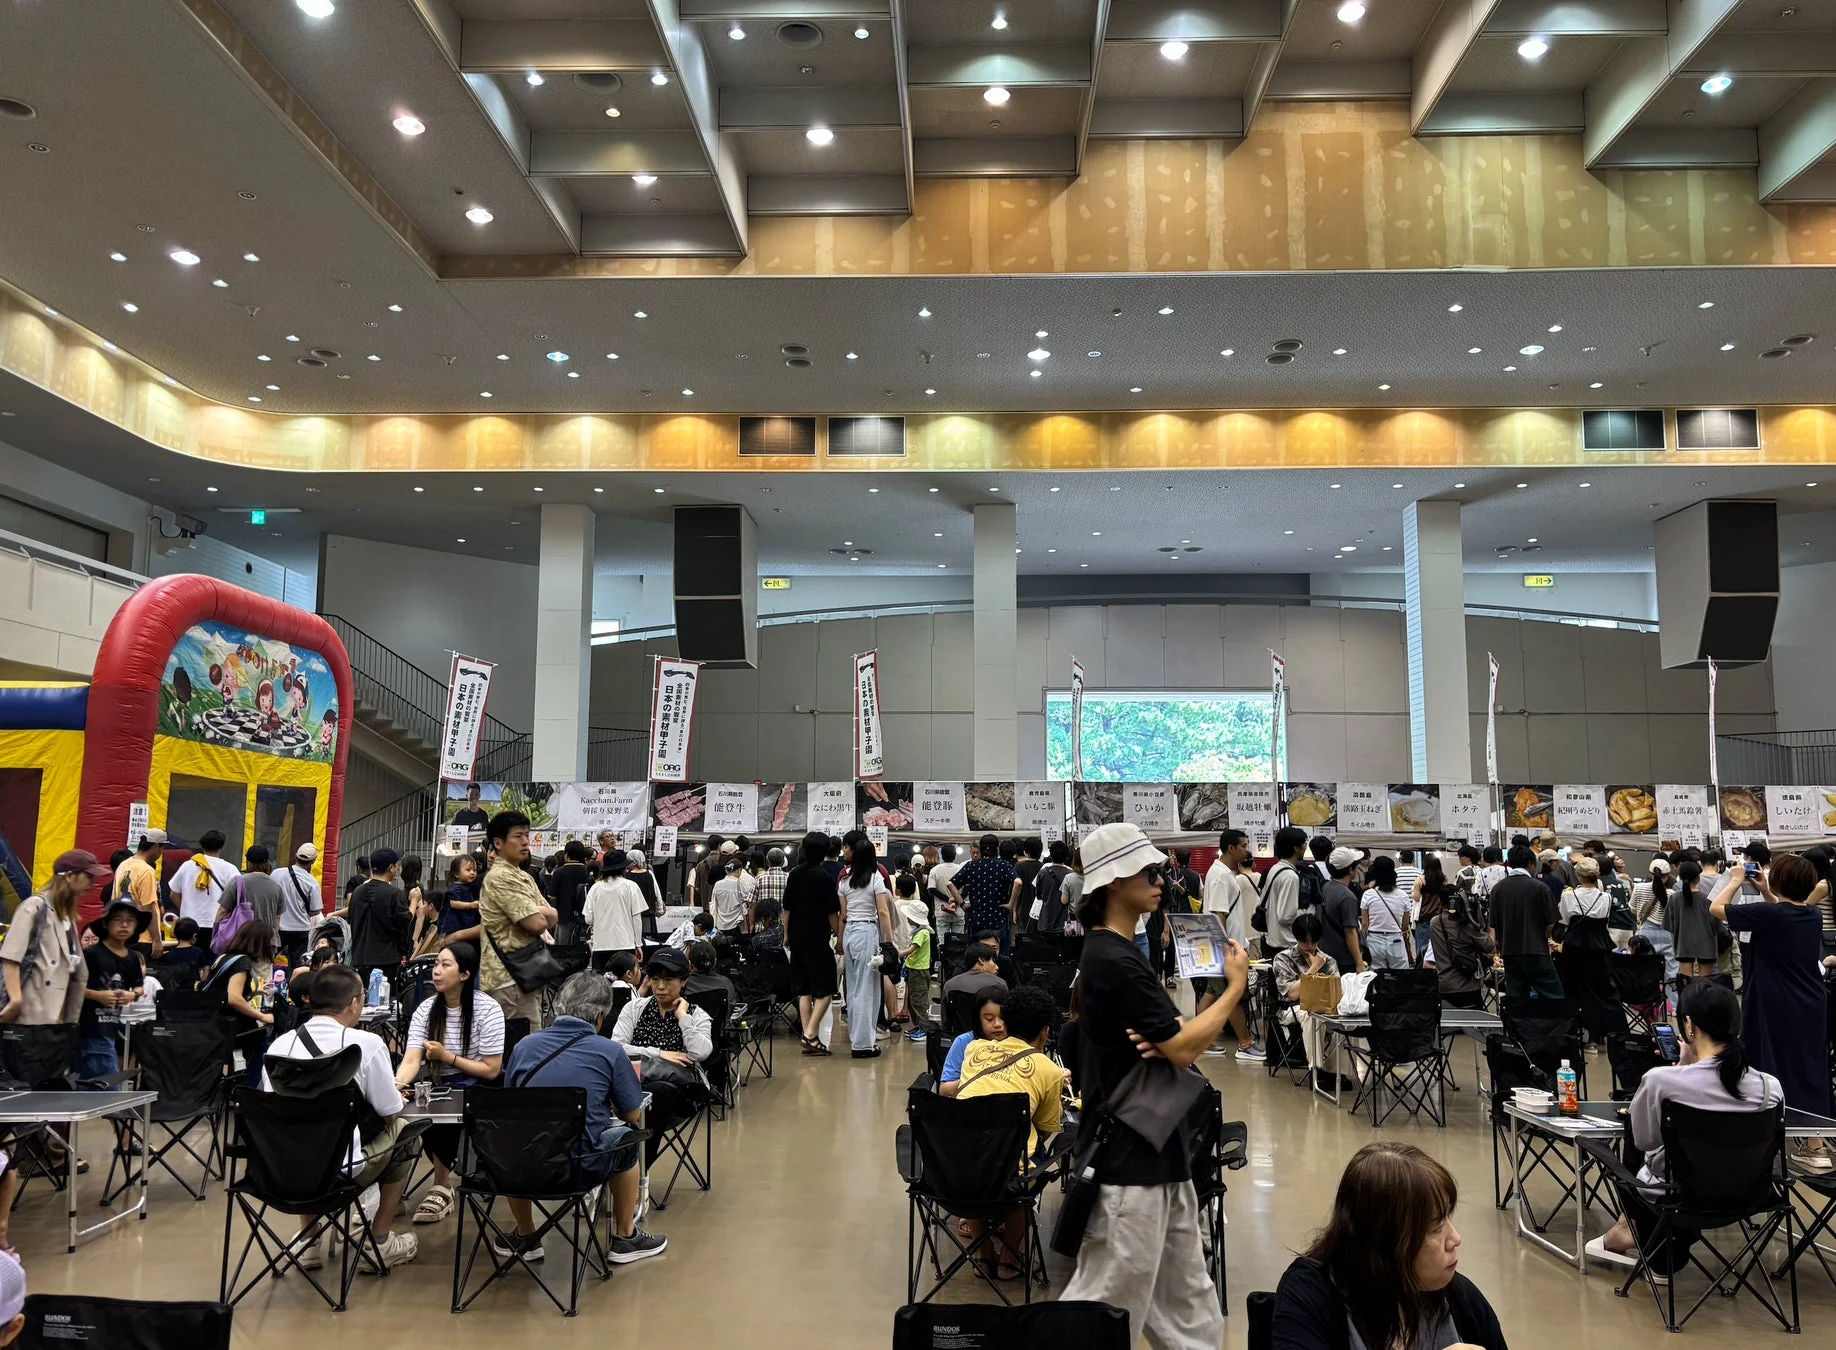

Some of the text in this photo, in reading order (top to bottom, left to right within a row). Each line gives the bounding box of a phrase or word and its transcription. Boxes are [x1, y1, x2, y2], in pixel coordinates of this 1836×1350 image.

[448, 684, 467, 757] 日本の素材甲子園
[657, 685, 674, 759] 日本の素材甲子園
[451, 762, 469, 771] ORG
[663, 763, 681, 772] ORG
[714, 802, 745, 813] 能登牛
[813, 803, 853, 812] なにわ黒牛
[922, 801, 953, 811] 能登豚
[1025, 802, 1056, 811] いもこ豚
[1135, 803, 1164, 813] ひいか
[1343, 804, 1382, 814] 淡路玉ねぎ
[1452, 805, 1478, 813] ホタテ
[1558, 806, 1600, 815] 紀州うめどり
[1776, 806, 1811, 816] しいたけ
